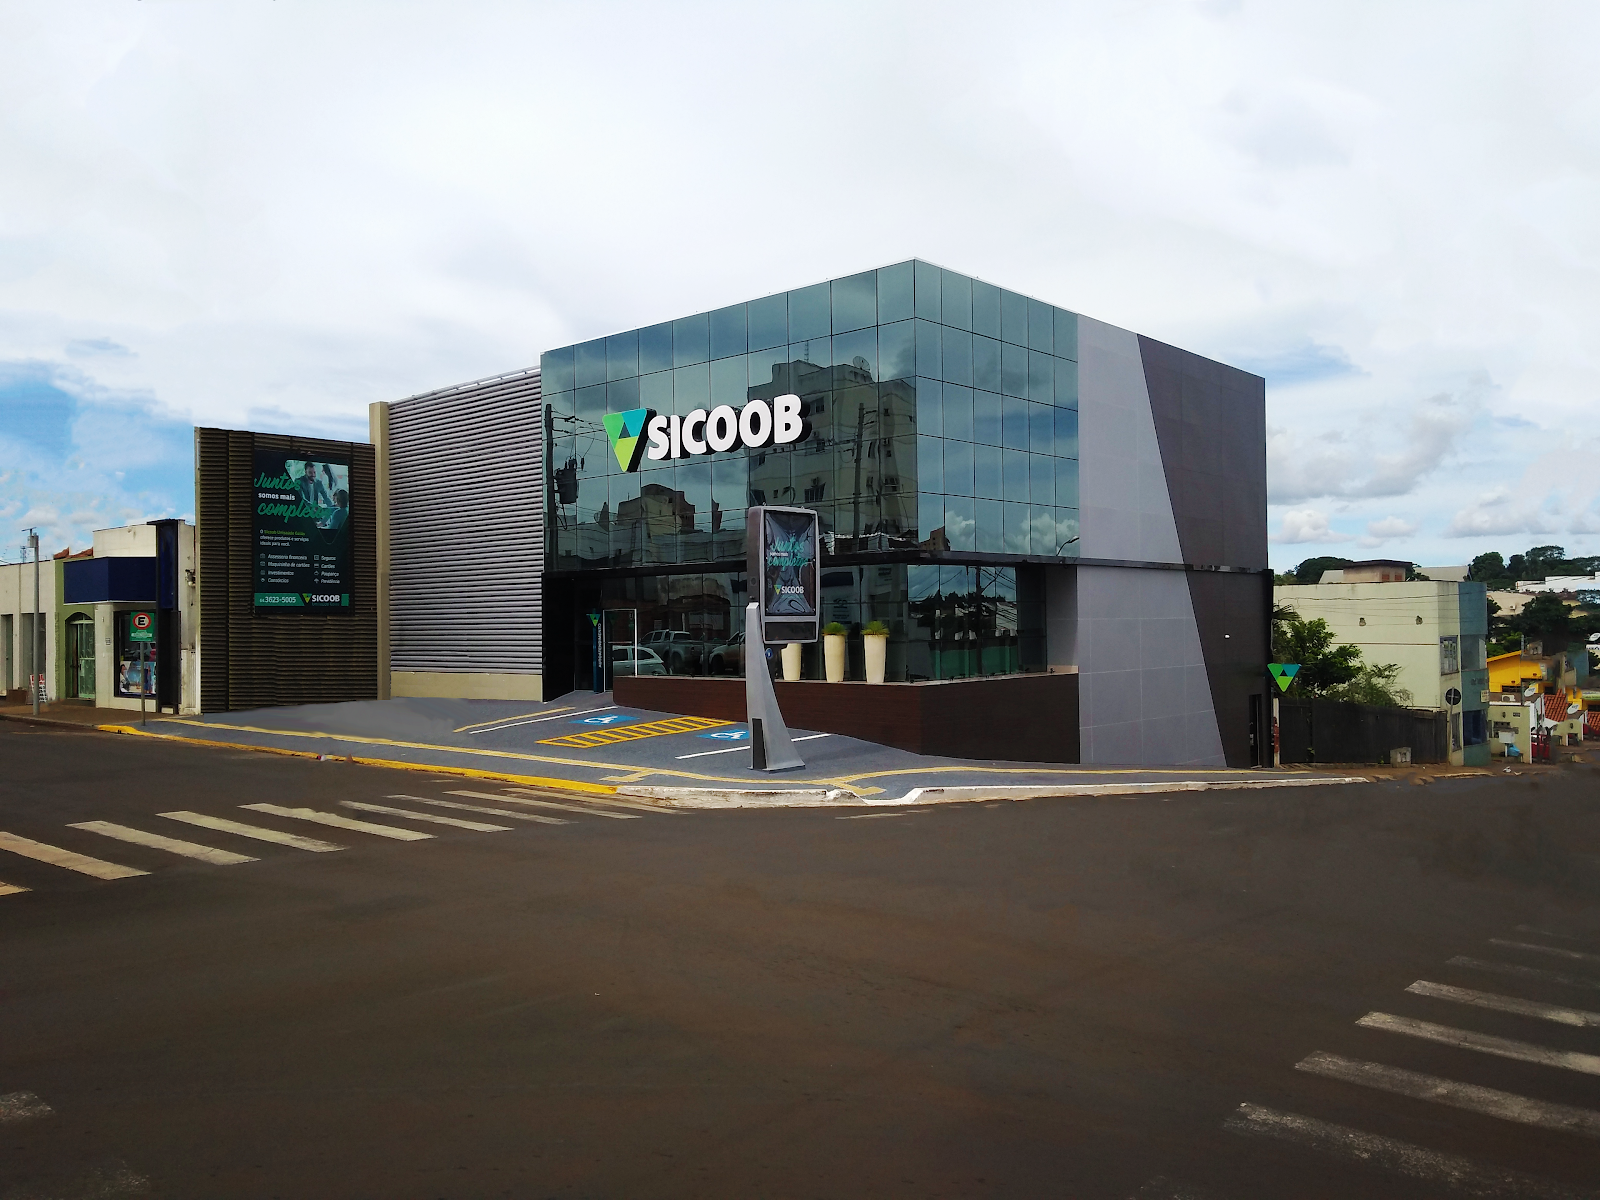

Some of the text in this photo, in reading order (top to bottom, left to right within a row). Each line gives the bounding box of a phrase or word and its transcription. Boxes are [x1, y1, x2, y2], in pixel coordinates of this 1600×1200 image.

[647, 393, 804, 461] SICOOB
[254, 471, 302, 491] Juntos
[258, 492, 296, 501] somos mais
[770, 537, 804, 552] Juntos
[781, 586, 804, 594] SICOOB
[264, 596, 296, 604] 3623-5005
[311, 594, 340, 602] SICOOB
[137, 616, 146, 625] E
